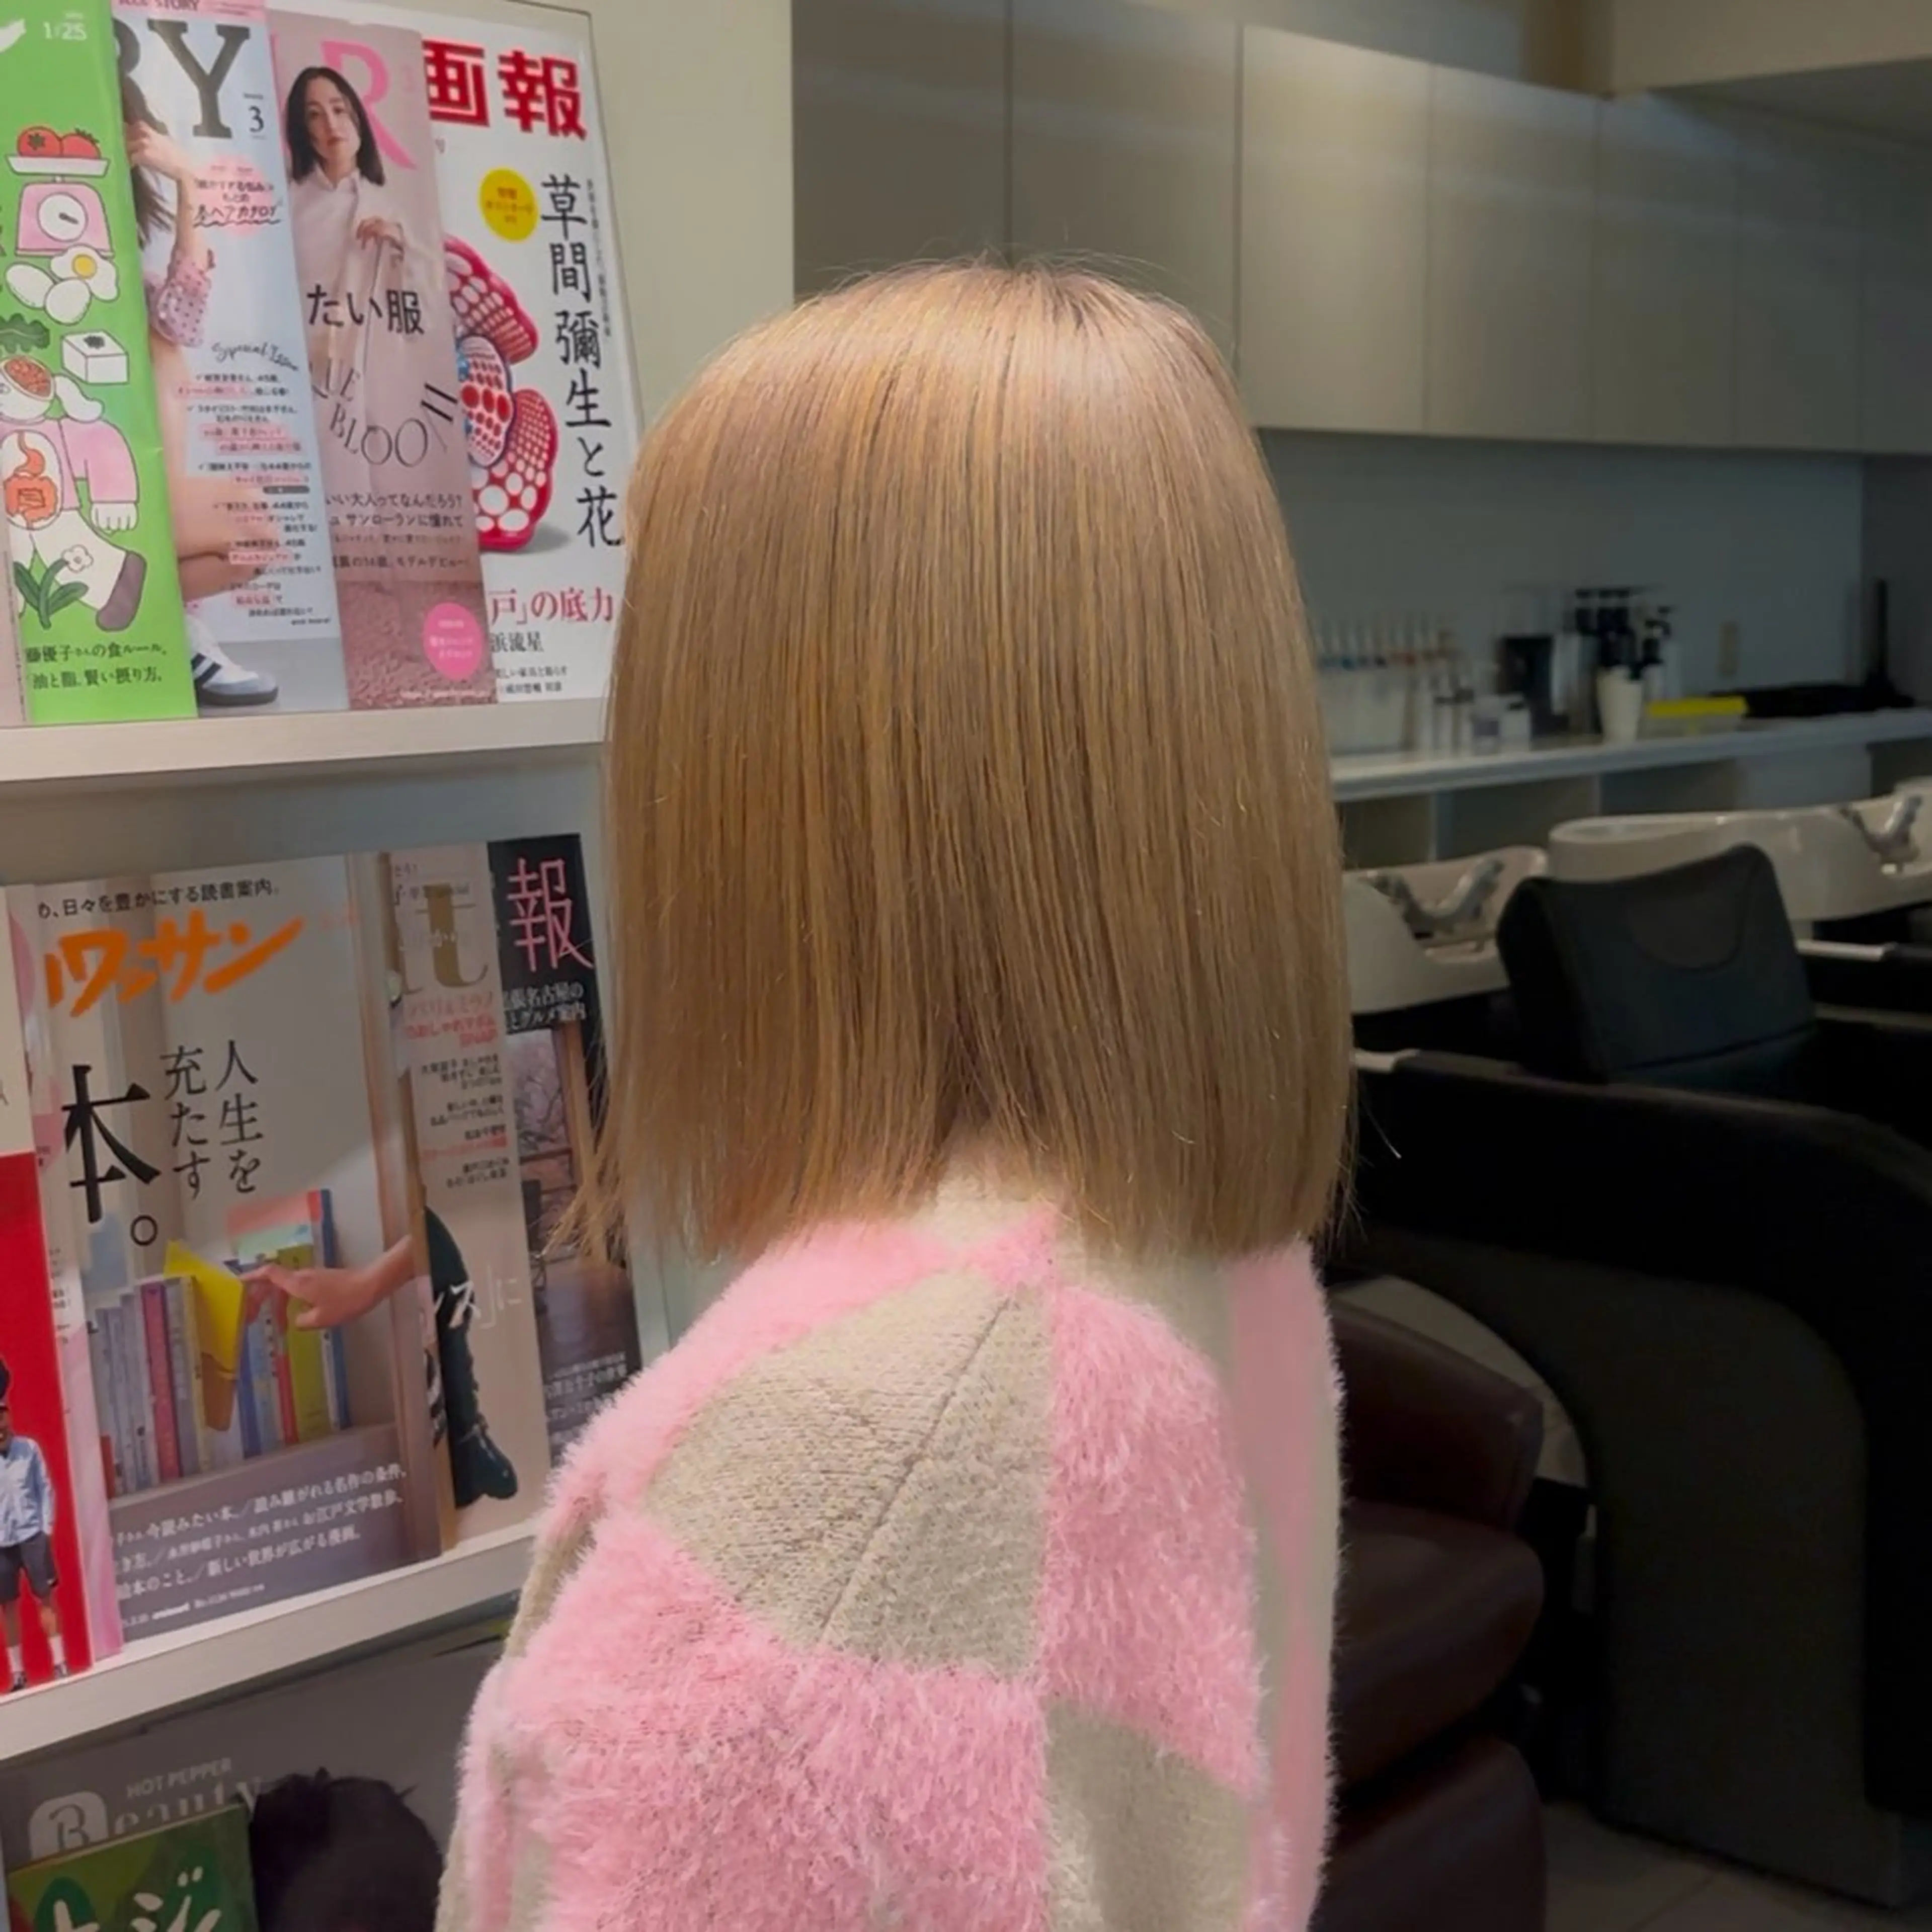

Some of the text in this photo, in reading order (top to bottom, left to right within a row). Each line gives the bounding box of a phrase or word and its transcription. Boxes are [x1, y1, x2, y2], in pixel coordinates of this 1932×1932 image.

[249, 106, 264, 134] 3
[422, 39, 587, 141] 画報
[308, 284, 425, 335] たい服
[540, 173, 624, 548] 草間彌生と花
[506, 856, 595, 973] 報
[159, 1044, 210, 1199] 充たす
[214, 1039, 264, 1193] 人生を
